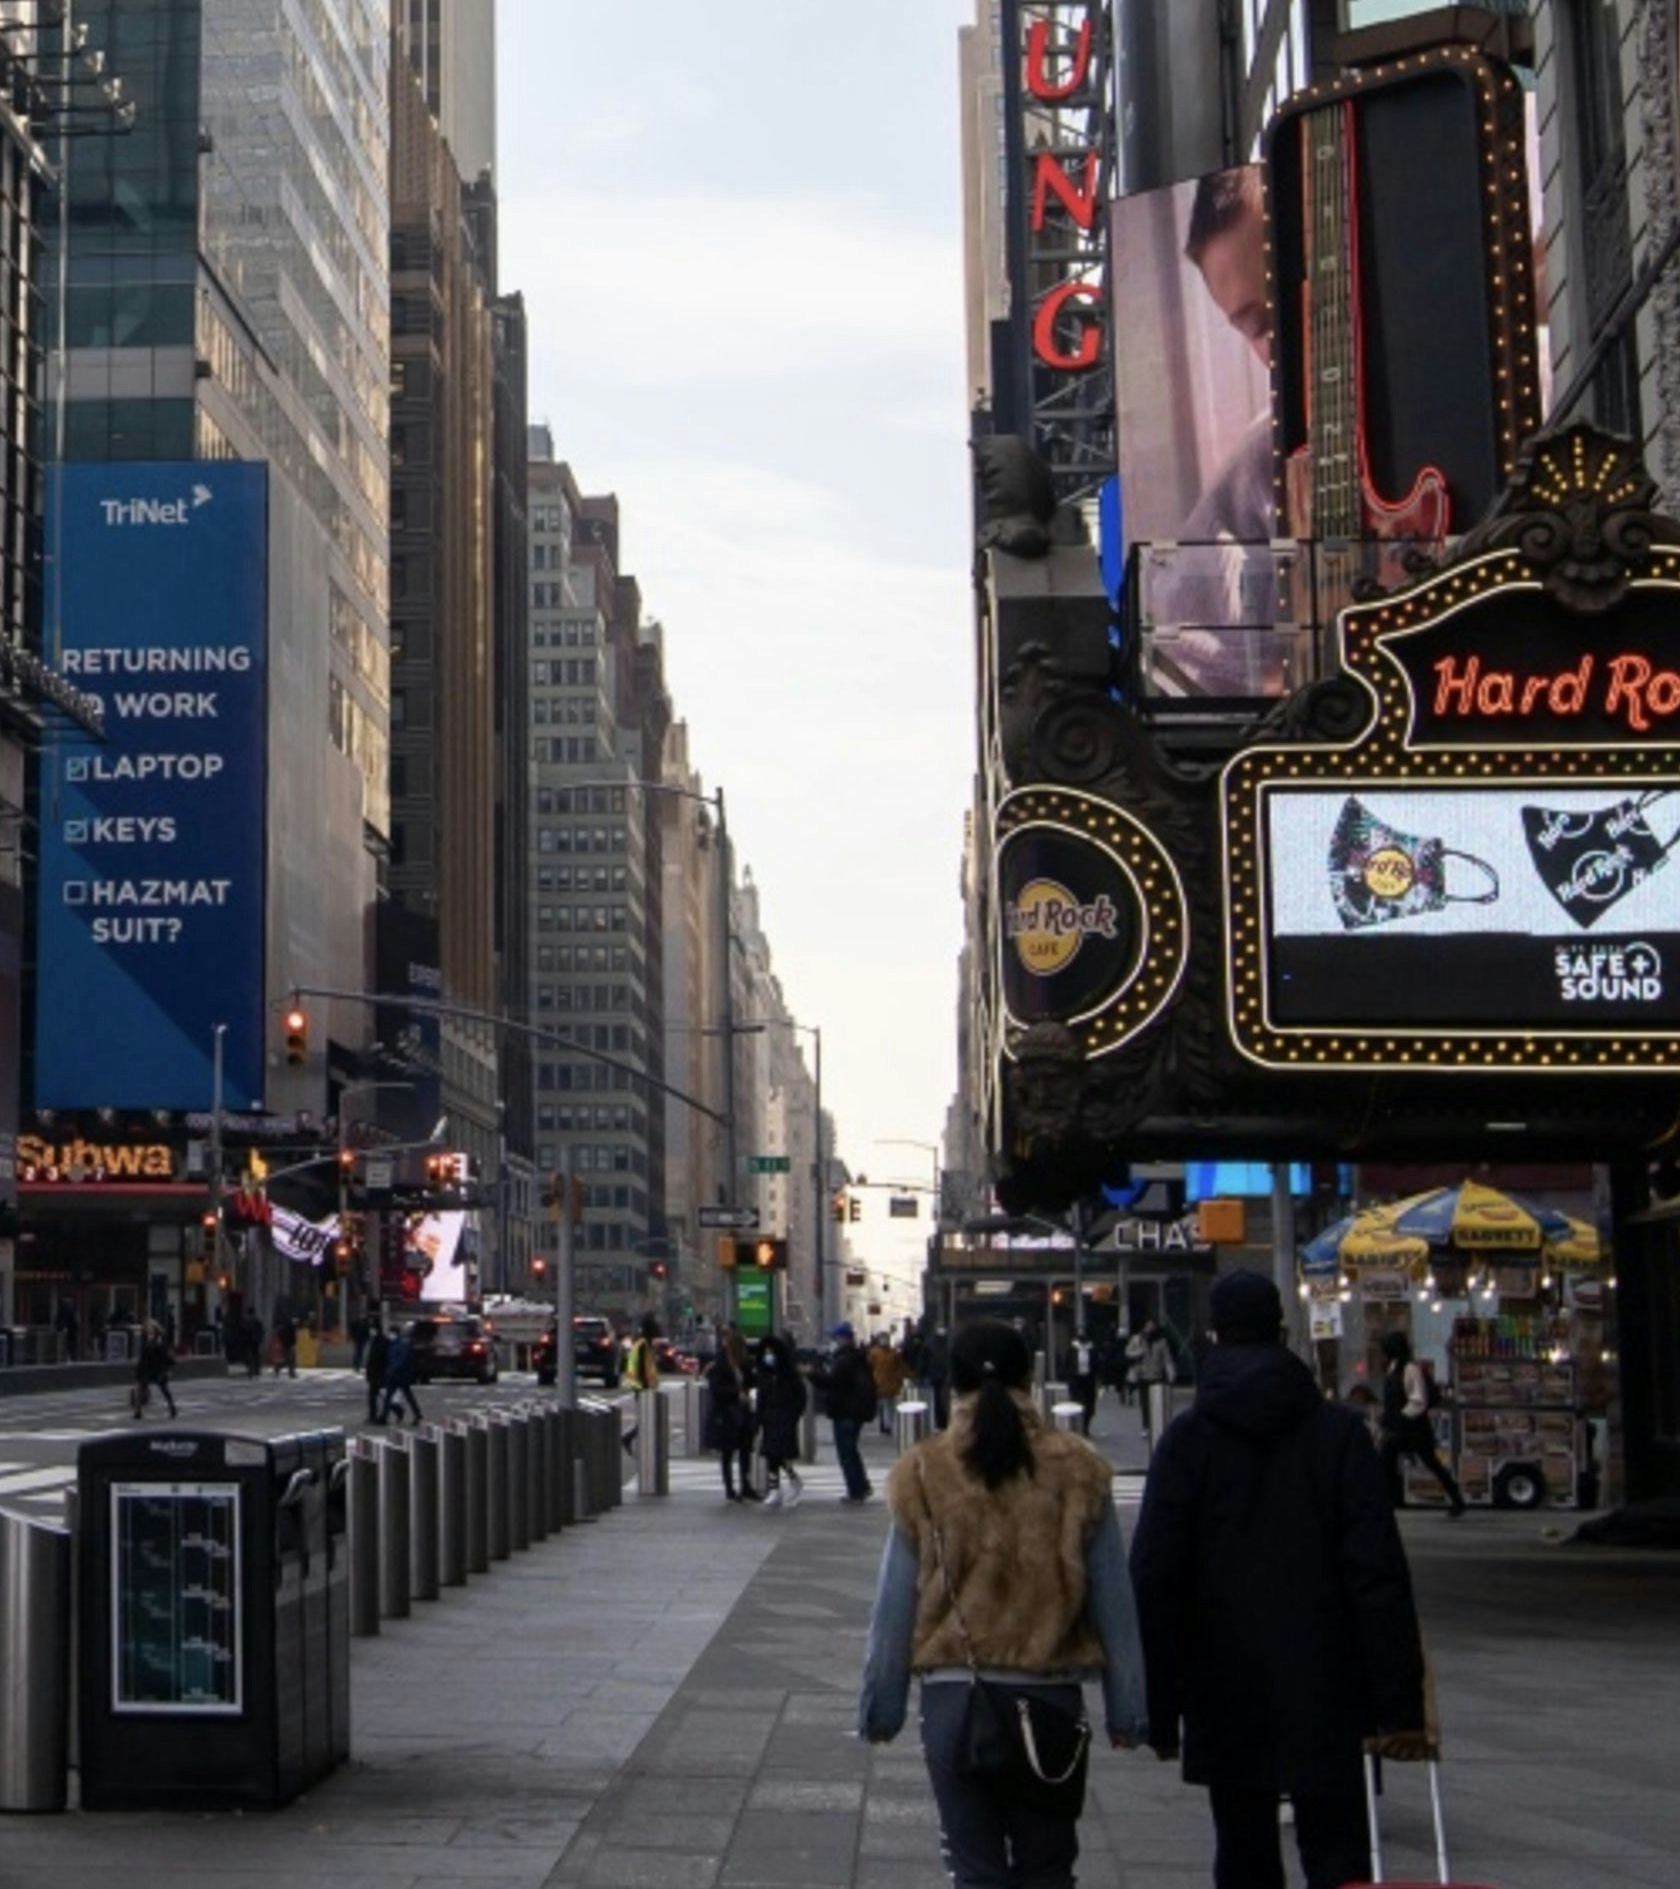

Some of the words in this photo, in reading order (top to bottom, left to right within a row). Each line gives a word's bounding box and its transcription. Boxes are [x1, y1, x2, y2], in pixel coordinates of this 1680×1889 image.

[101, 498, 189, 526] TriNet
[61, 646, 251, 675] RETURNING
[1434, 654, 1591, 717] Hard
[115, 692, 219, 719] WORK
[93, 754, 223, 781] LAPTOP
[93, 817, 177, 843] KEYS
[92, 879, 232, 906] HAZMAT
[1042, 893, 1119, 940] Rock
[91, 918, 183, 945] SUIT?
[1554, 953, 1626, 982] SAFE
[1561, 976, 1663, 1001] SOUND
[1114, 1219, 1210, 1251] CHAS
